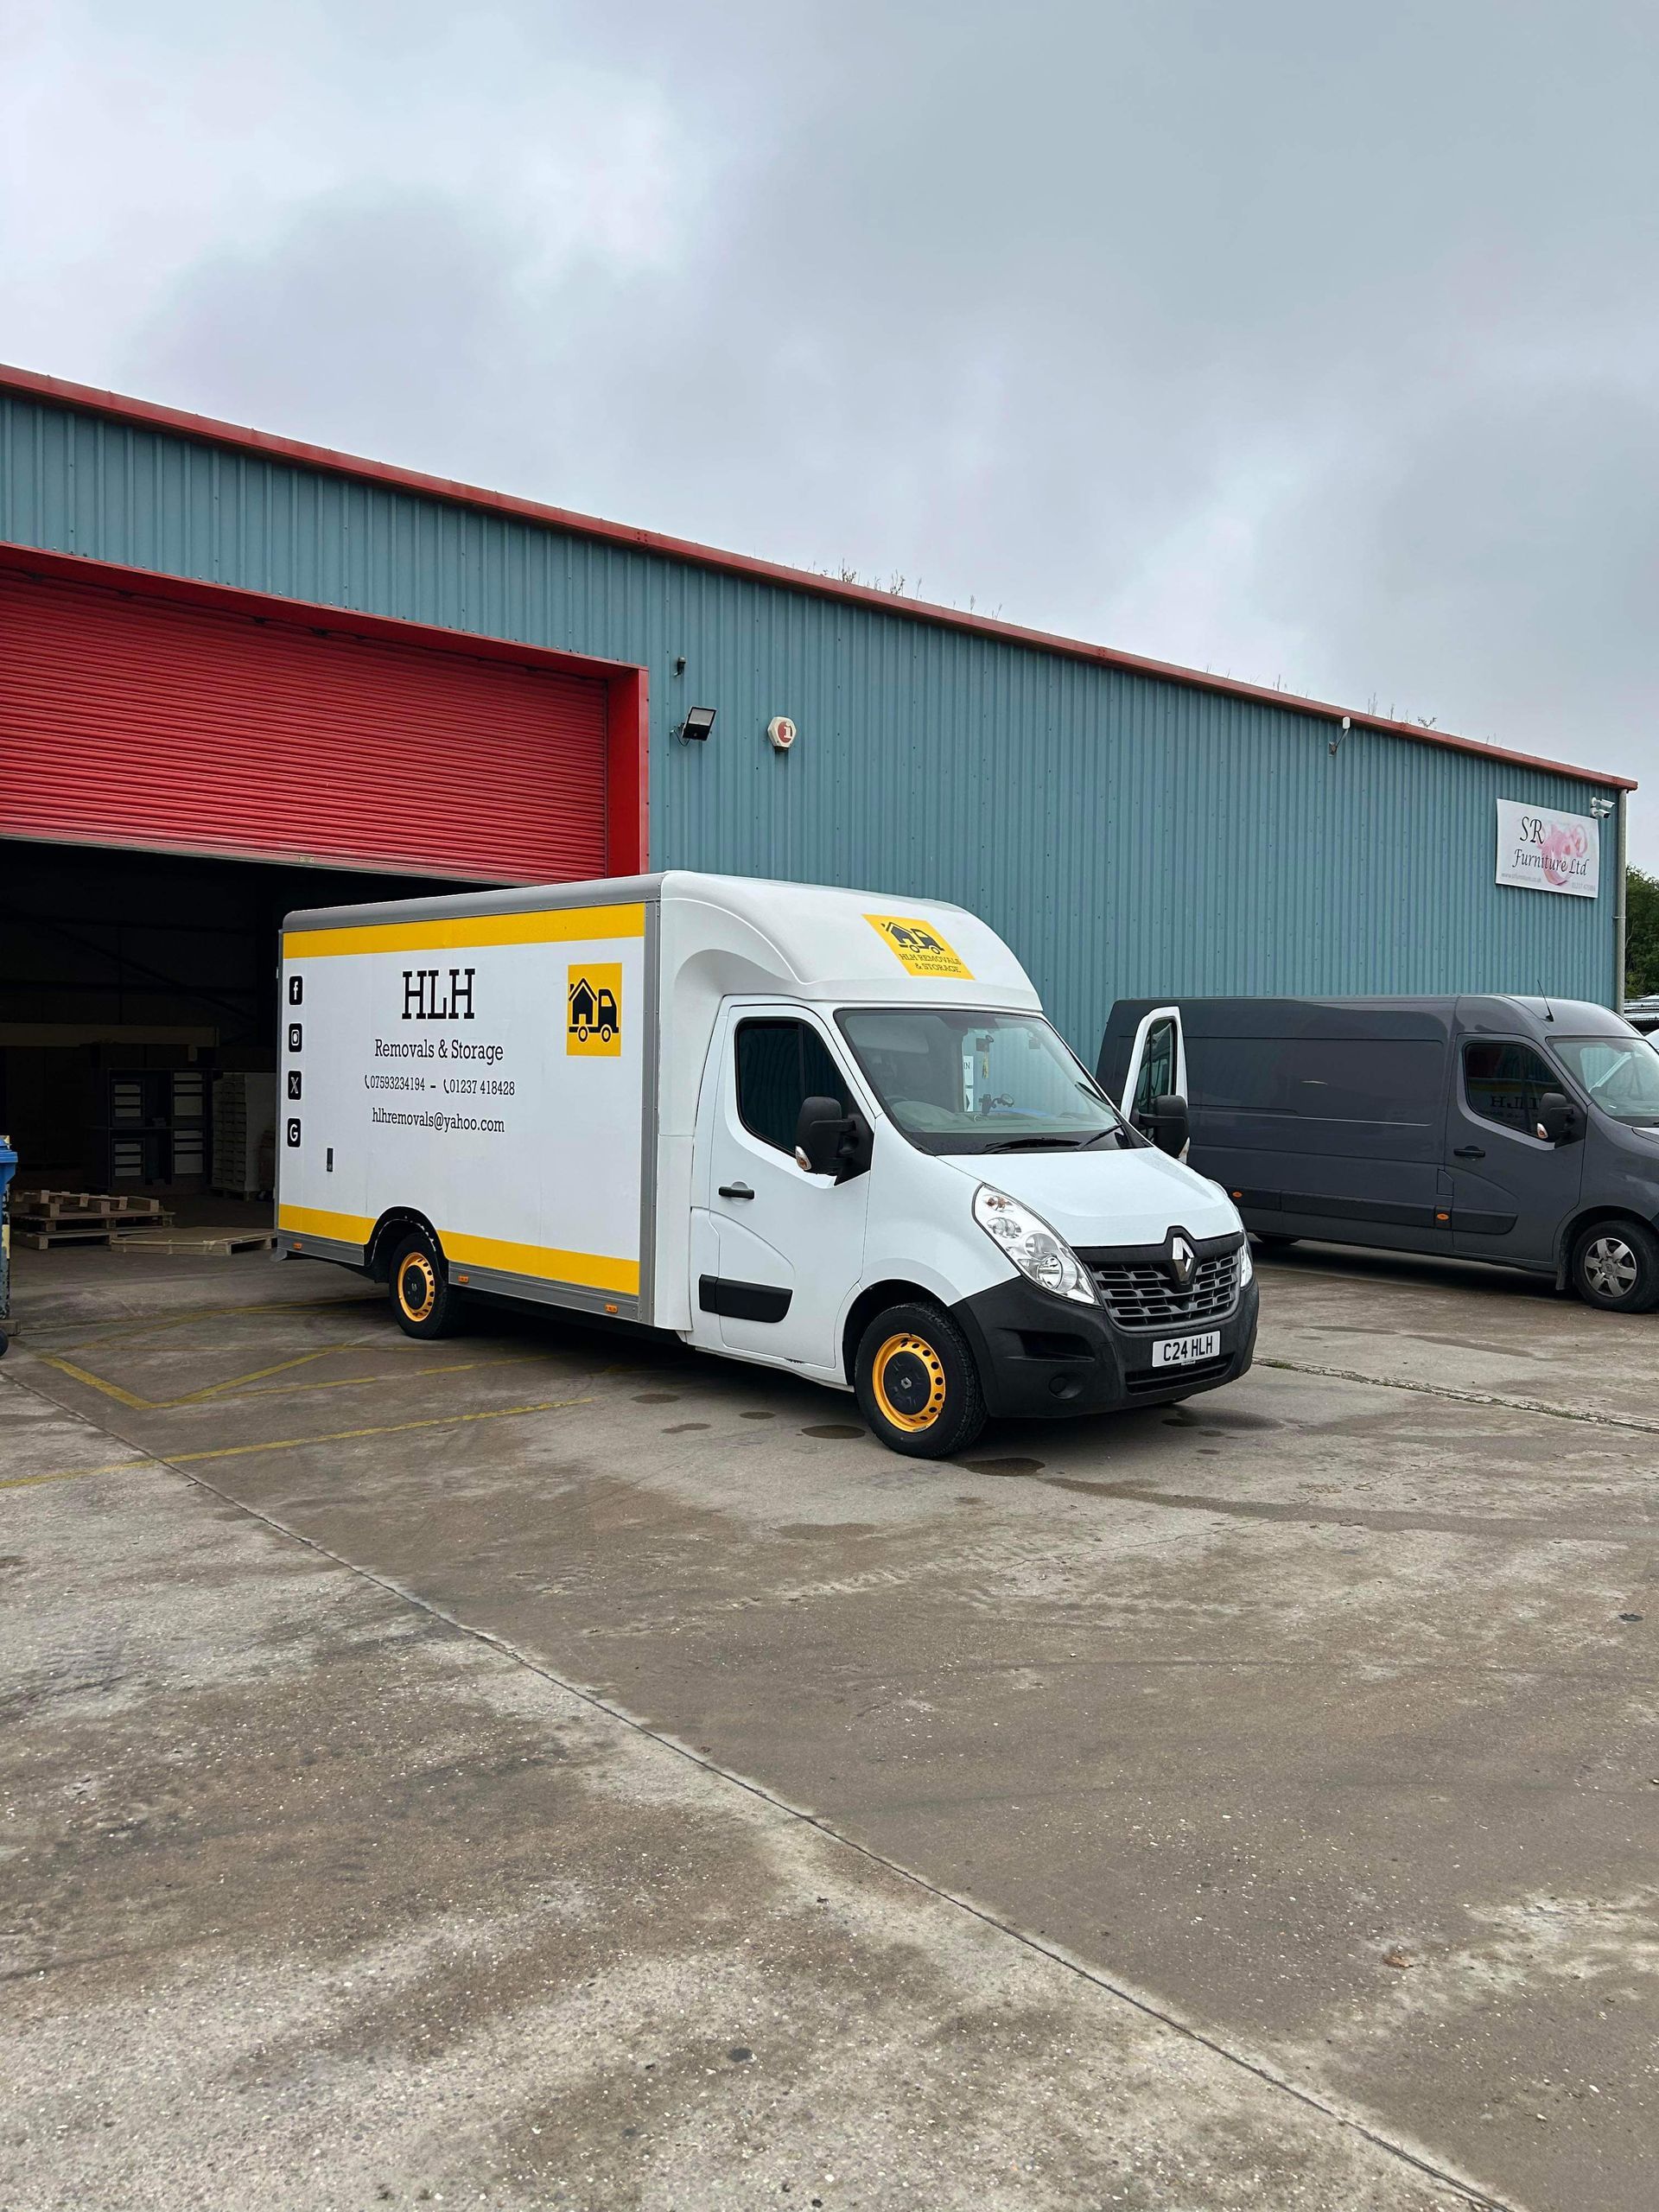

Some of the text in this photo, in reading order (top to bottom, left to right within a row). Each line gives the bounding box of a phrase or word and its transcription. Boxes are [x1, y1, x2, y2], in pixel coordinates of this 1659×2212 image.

[1520, 816, 1545, 844] SR
[1512, 849, 1590, 876] Furniture Ltd
[918, 955, 962, 965] REMOVALS
[923, 963, 962, 973] STORAGE
[402, 968, 475, 1020] HLH
[374, 1039, 504, 1065] Removals & Storage
[371, 1075, 425, 1090] 07593234194
[449, 1079, 477, 1094] 01237
[480, 1080, 515, 1096] 418428
[372, 1107, 505, 1133] hlhremovals@yahoo.com
[1164, 1335, 1213, 1362] C24 HLH
